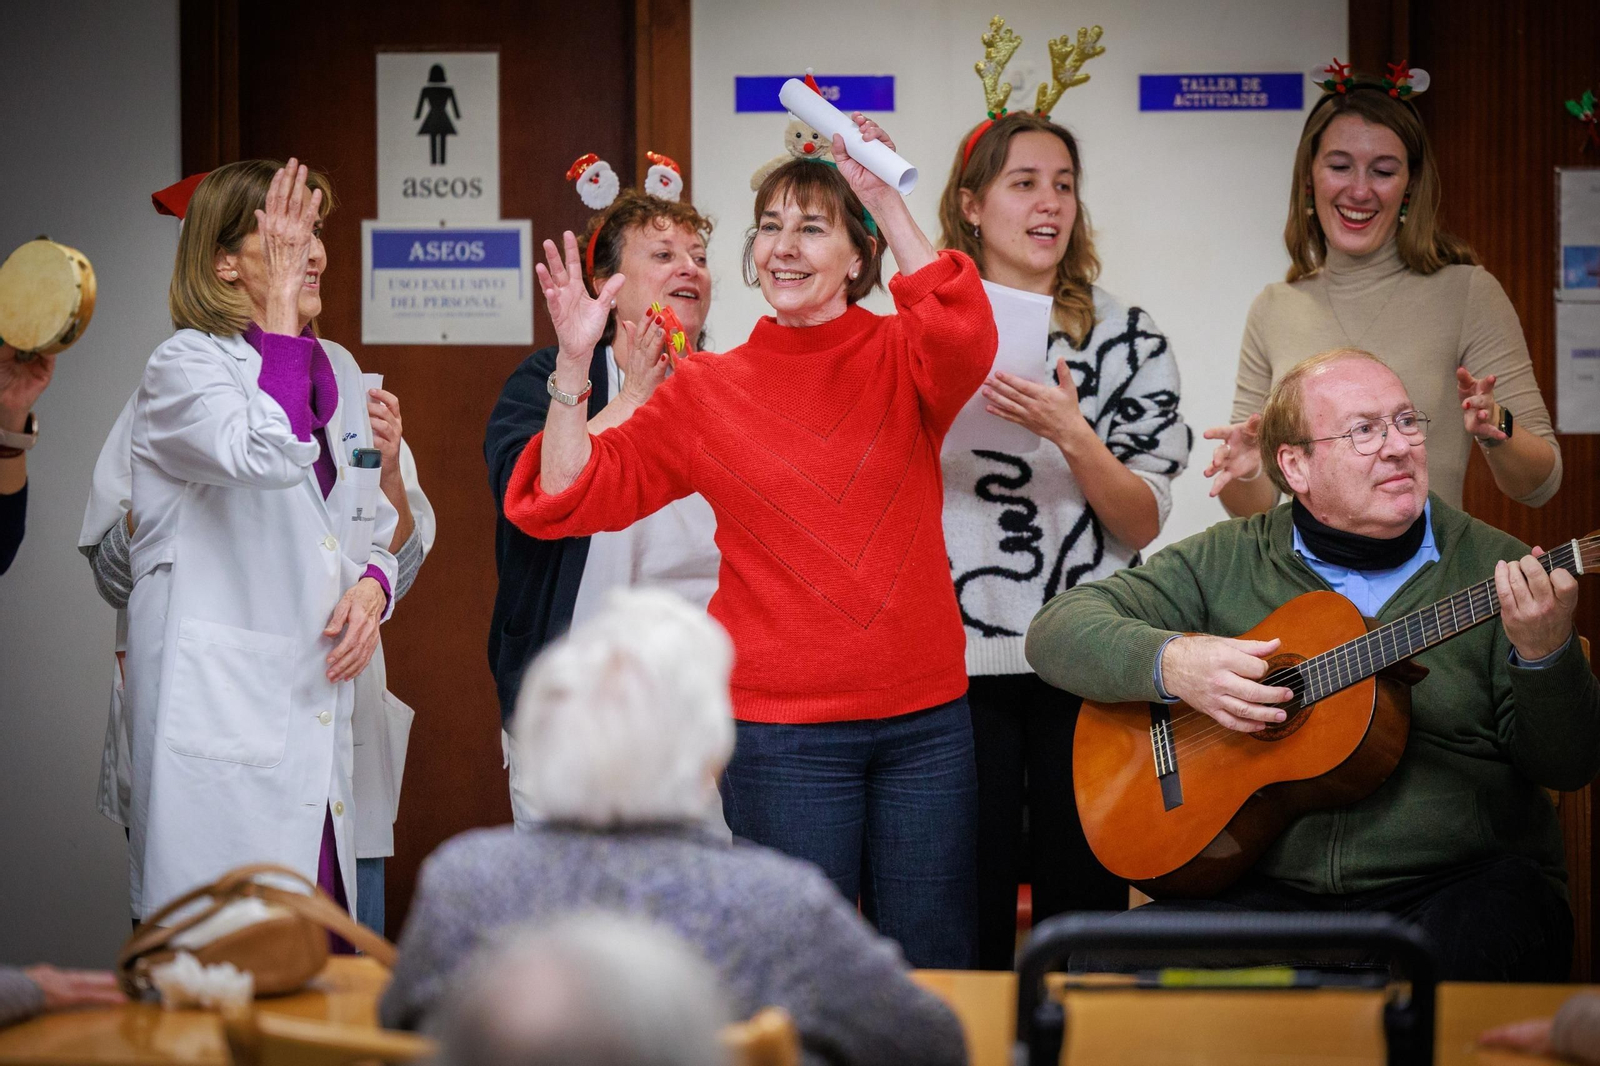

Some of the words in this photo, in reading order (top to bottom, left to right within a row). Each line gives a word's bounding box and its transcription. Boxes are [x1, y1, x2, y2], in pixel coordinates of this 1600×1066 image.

[1180, 77, 1237, 92] TALLER
[1241, 77, 1262, 91] DE
[1173, 93, 1269, 108] ACTIVIDADES
[402, 176, 483, 198] aseos
[408, 240, 486, 262] ASEOS
